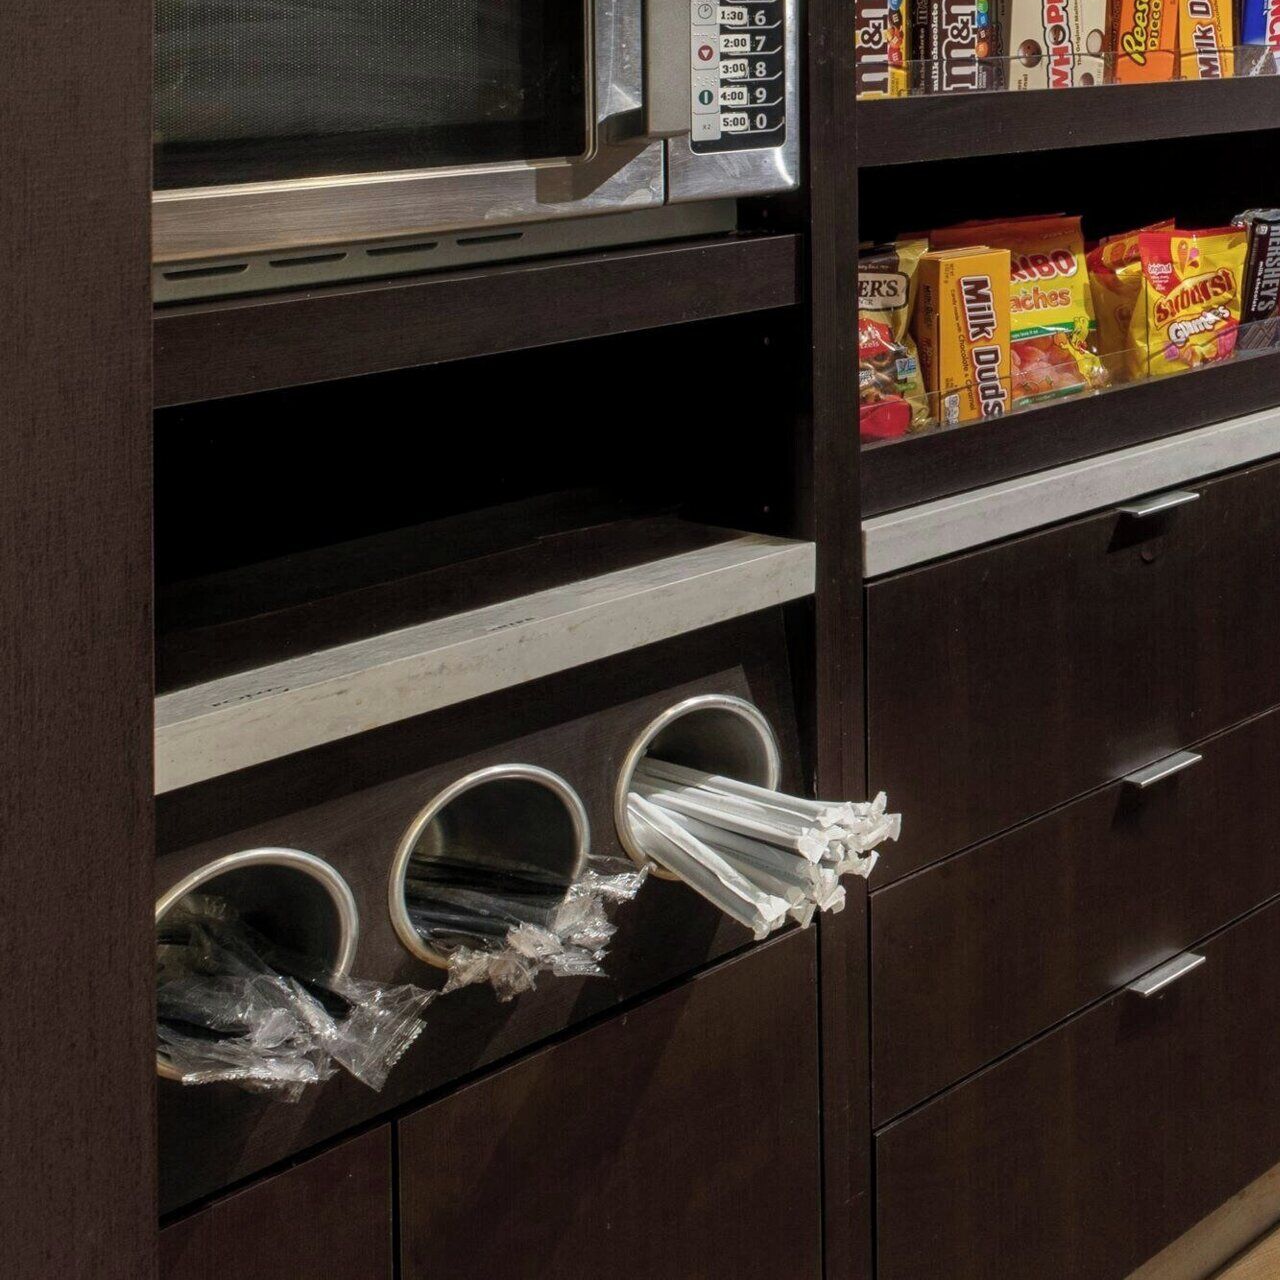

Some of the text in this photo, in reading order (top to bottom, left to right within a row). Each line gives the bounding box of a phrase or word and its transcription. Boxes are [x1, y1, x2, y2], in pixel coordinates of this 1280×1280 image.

[720, 11, 744, 21] 1:30
[755, 10, 766, 25] 6
[931, 2, 939, 60] chocolate
[723, 38, 747, 48] 2:00
[755, 36, 766, 51] 7
[722, 63, 746, 73] 3:00
[755, 61, 766, 77] 8
[720, 91, 744, 102] 4:00
[755, 87, 767, 104] 9
[722, 117, 747, 127] 5:00
[1010, 249, 1077, 285] RIBO
[1010, 287, 1072, 313] aches
[960, 275, 1008, 419] Milk Duds
